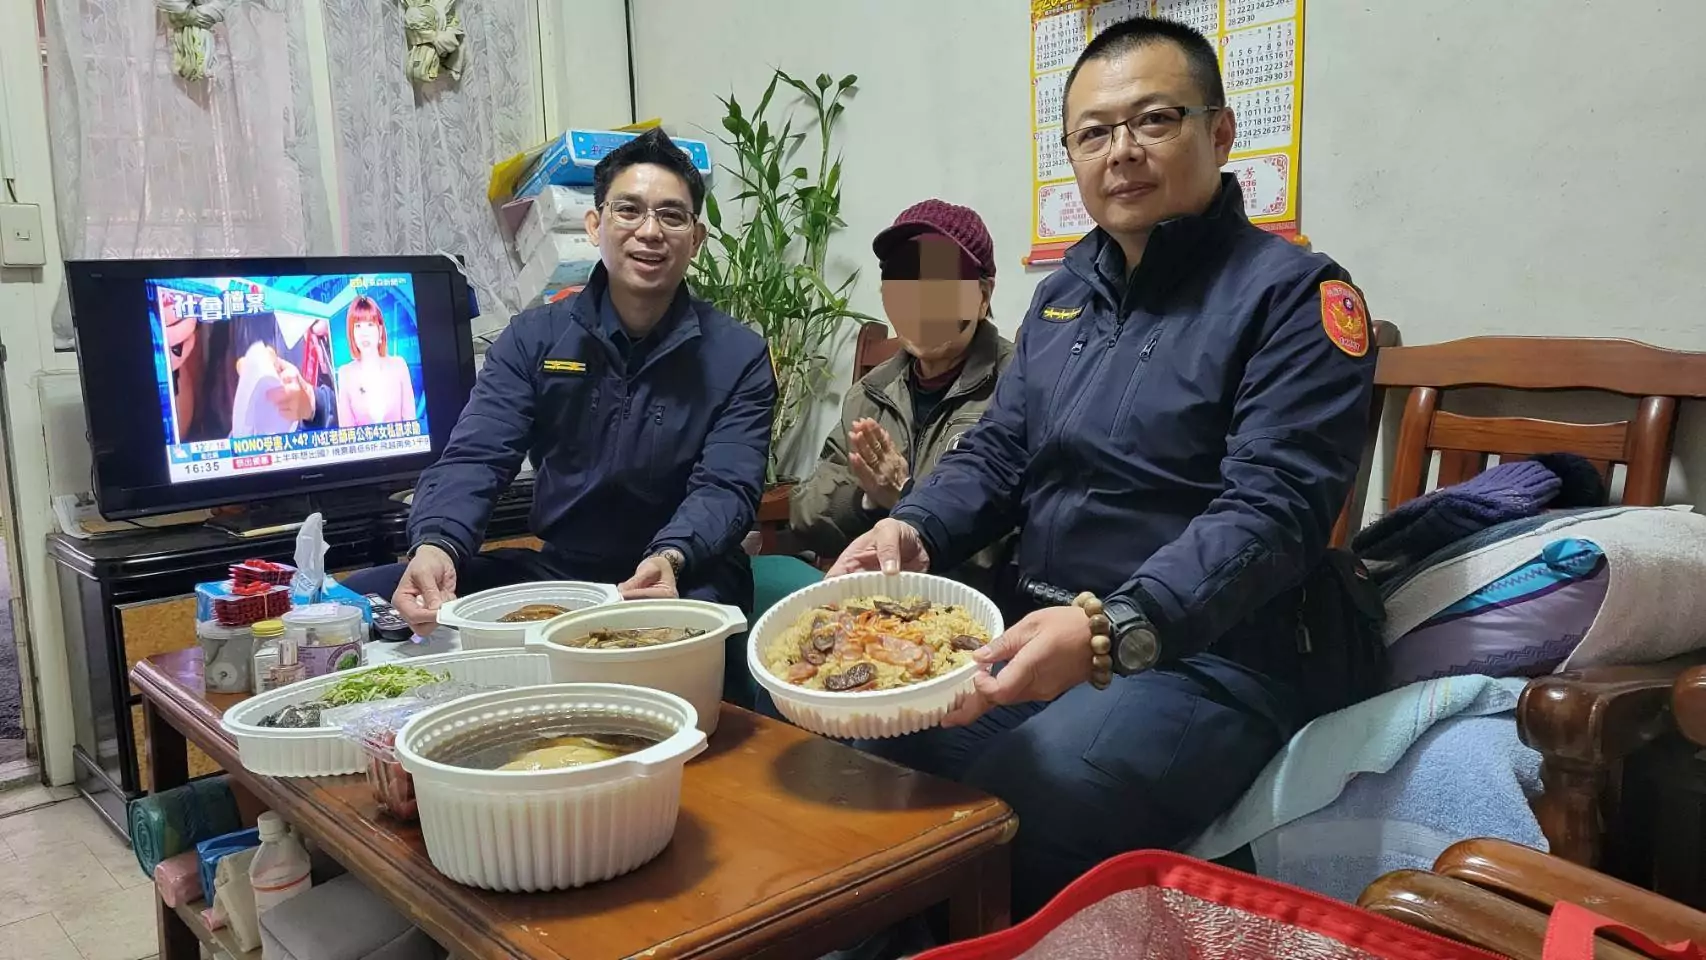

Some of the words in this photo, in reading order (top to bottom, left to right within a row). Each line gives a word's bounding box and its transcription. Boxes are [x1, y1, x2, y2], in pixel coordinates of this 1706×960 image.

[174, 290, 265, 320] 社會檔案
[184, 462, 220, 474] 16:35
